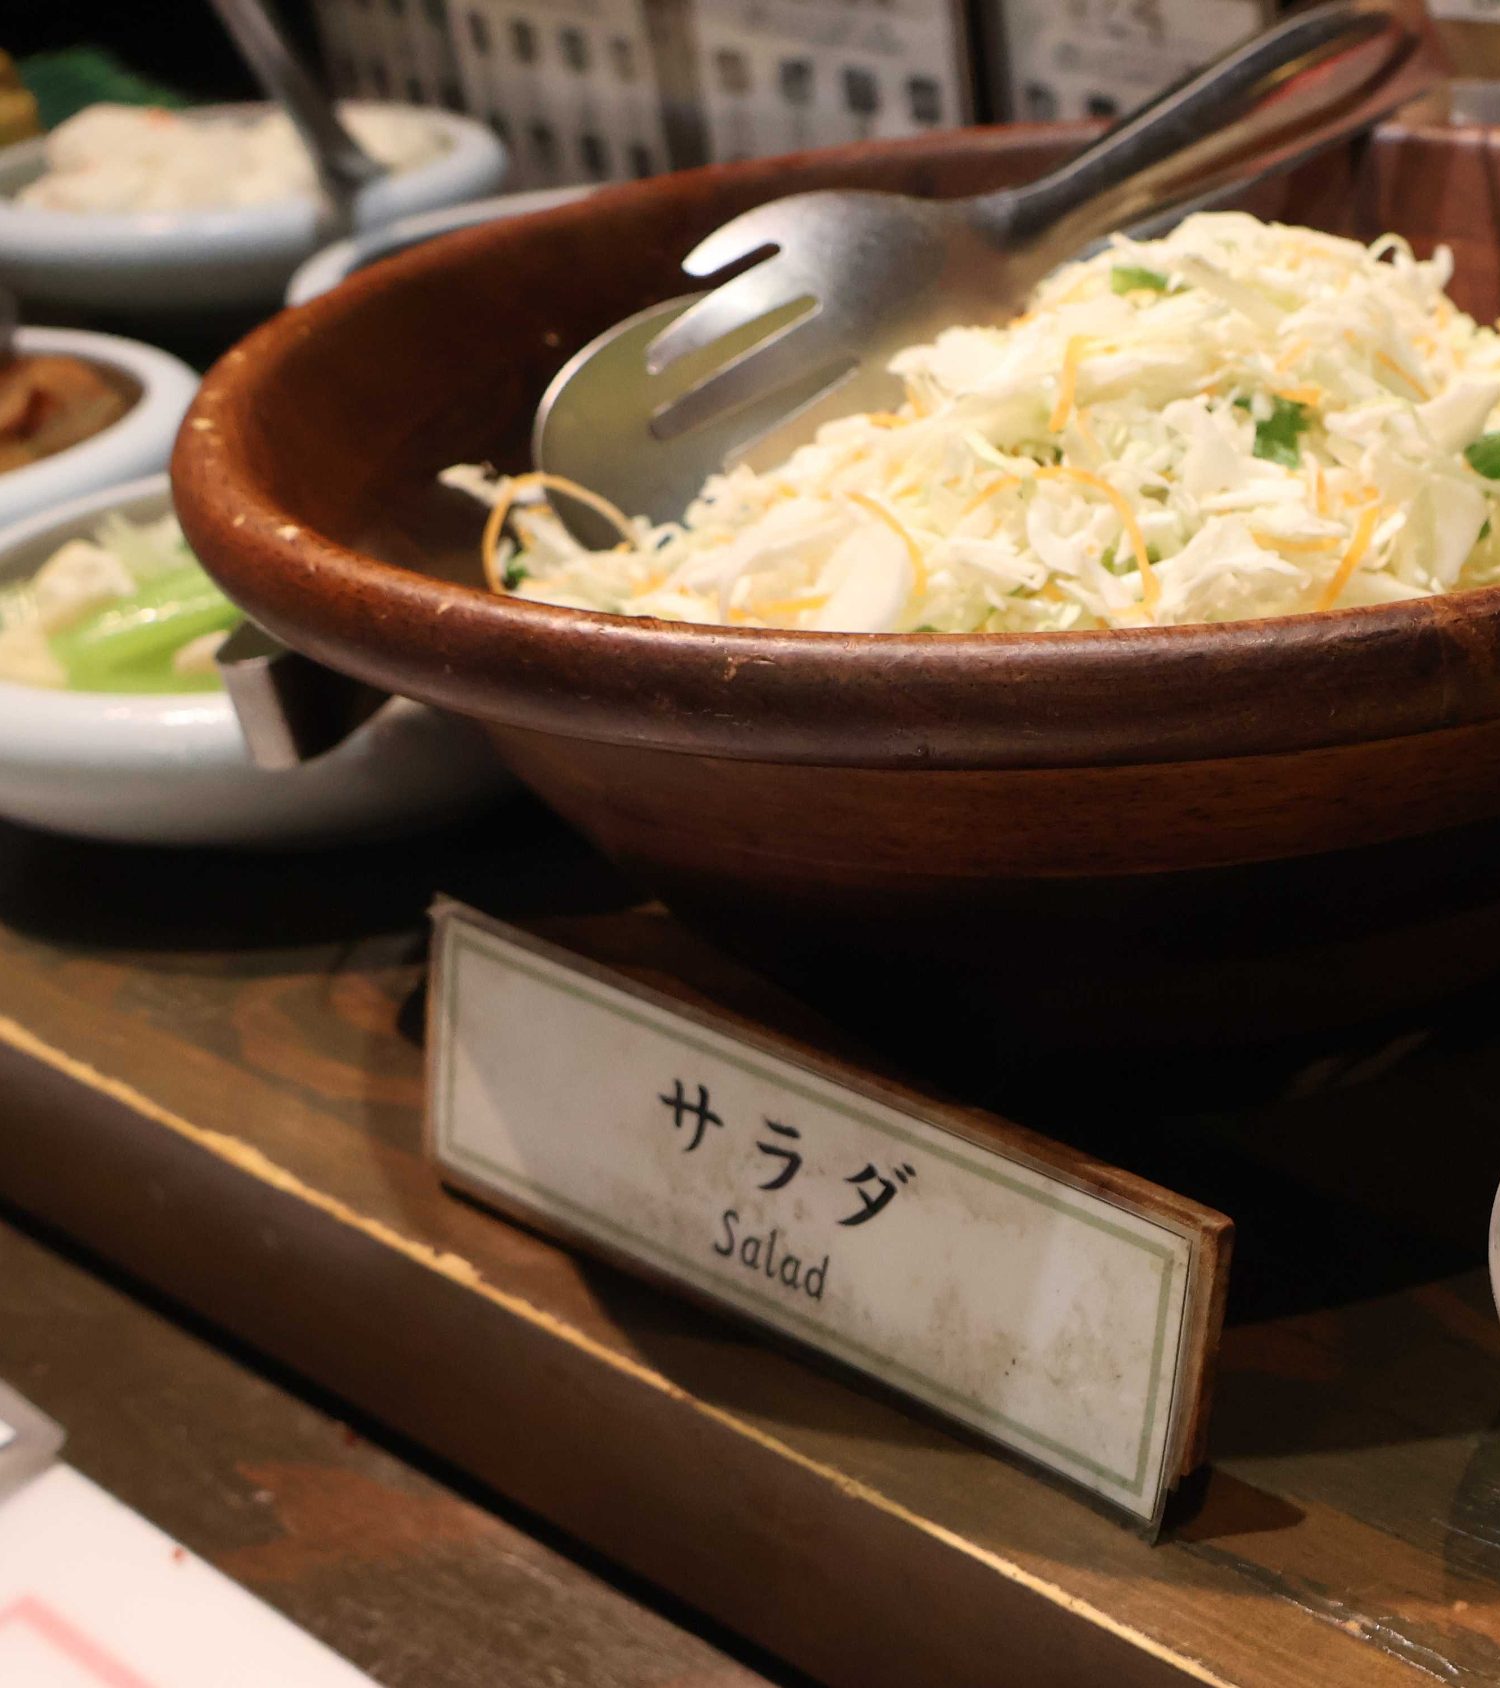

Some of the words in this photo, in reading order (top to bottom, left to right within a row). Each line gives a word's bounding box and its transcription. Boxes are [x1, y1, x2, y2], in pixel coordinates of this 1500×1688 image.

[658, 1078, 917, 1227] サラダ
[712, 1208, 830, 1301] Salad
